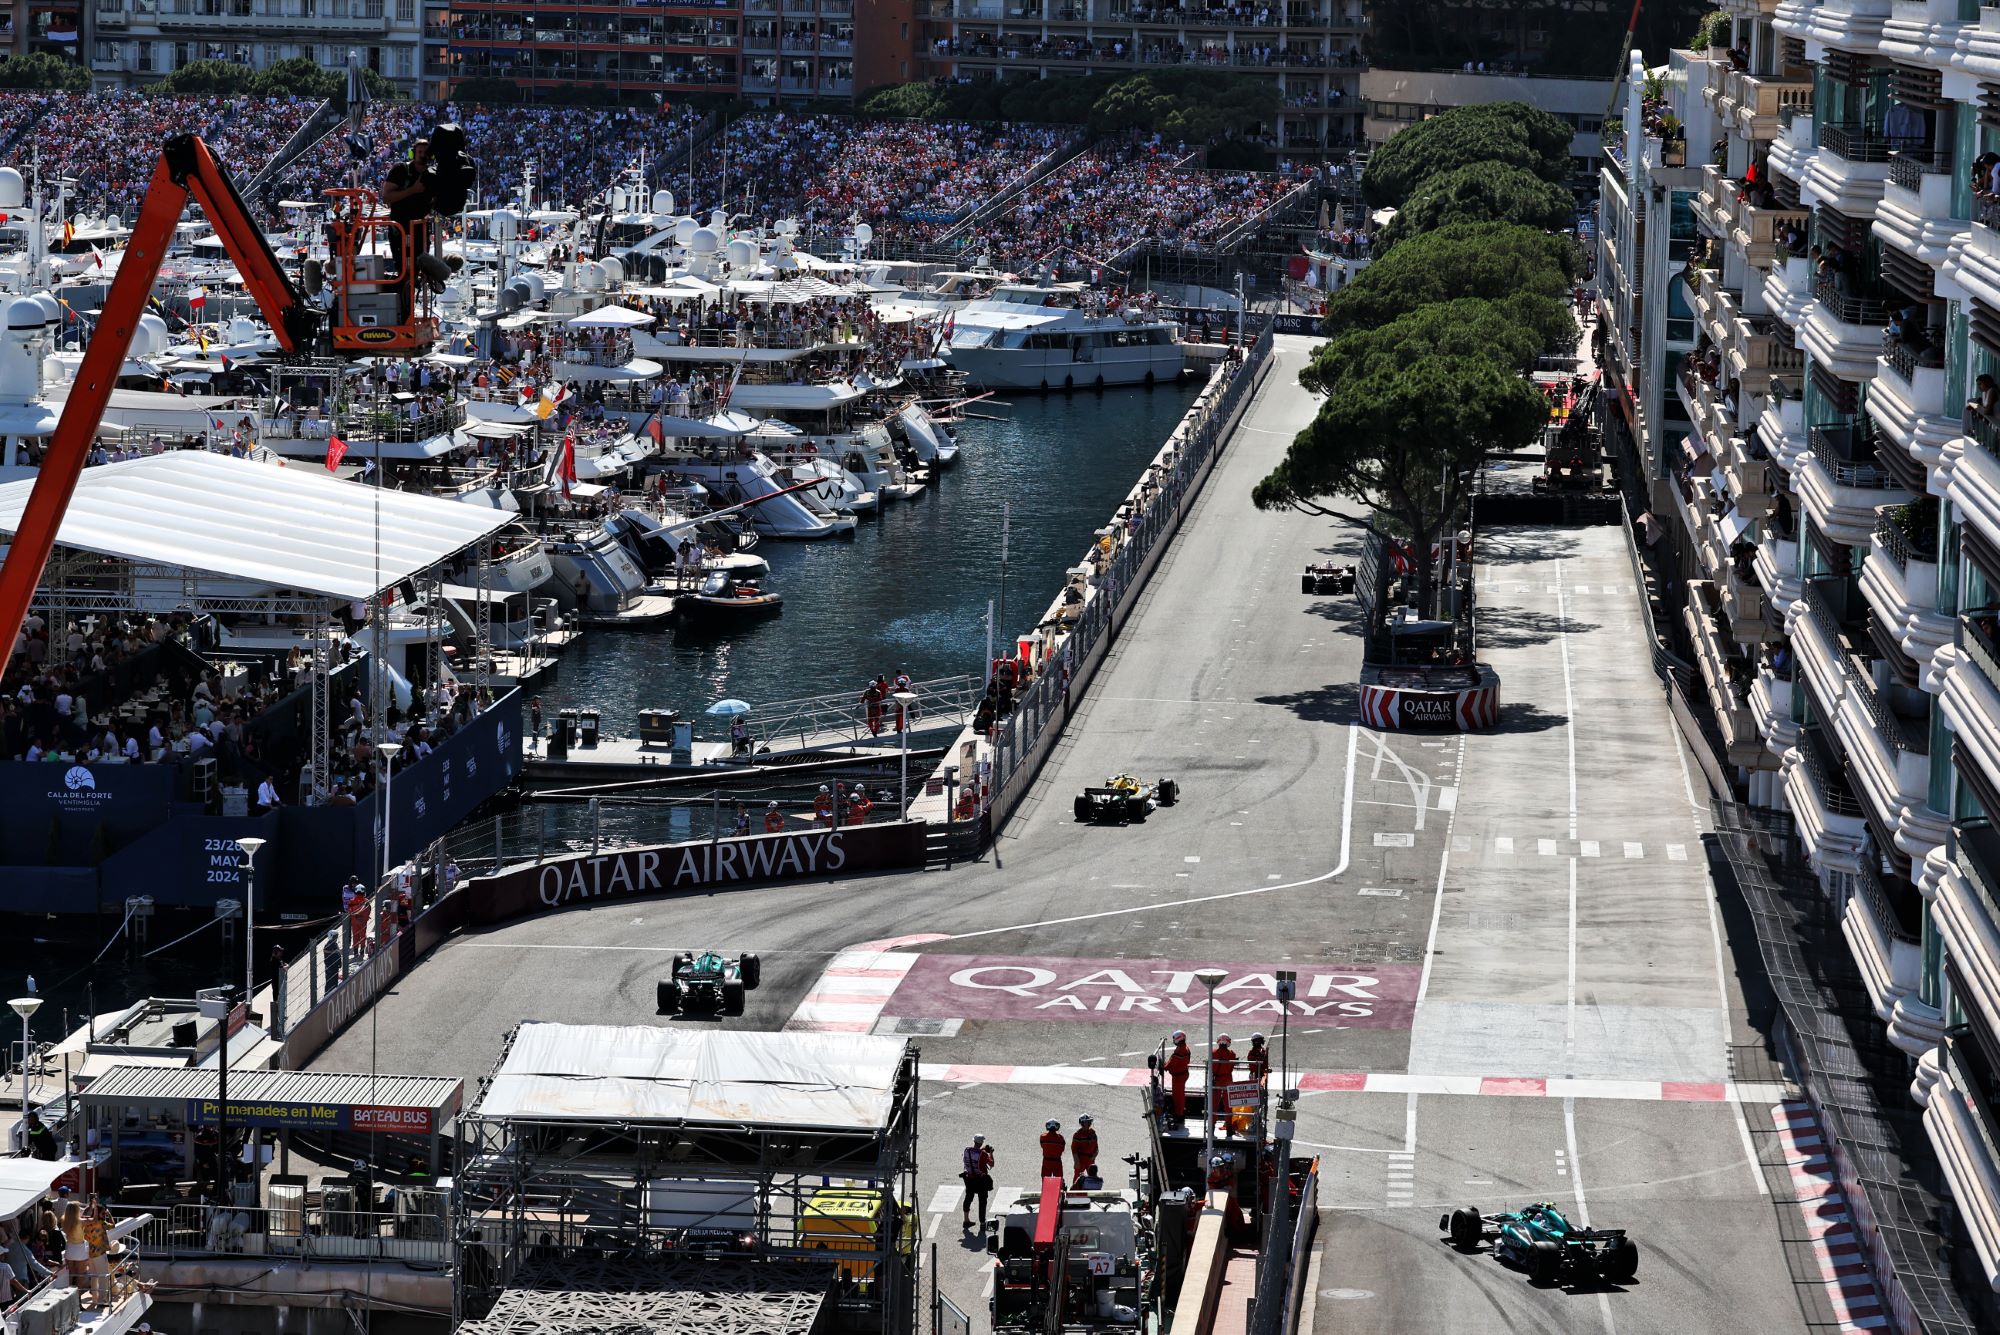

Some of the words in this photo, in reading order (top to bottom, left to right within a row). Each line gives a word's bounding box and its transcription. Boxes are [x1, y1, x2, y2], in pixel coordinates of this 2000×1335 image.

[1283, 318, 1301, 328] MSC
[1404, 700, 1450, 714] QATAR
[204, 839, 242, 851] 23/26
[210, 855, 240, 866] MAY
[540, 852, 662, 906] QATAR
[674, 832, 845, 885] AIRWAYS
[208, 870, 240, 882] 2024
[949, 966, 1382, 998] QATAR
[327, 980, 357, 1034] QATAR
[360, 946, 393, 1002] AIRWAYS
[1034, 994, 1374, 1017] AIRWAYS
[204, 1102, 288, 1116] Prmenades
[291, 1108, 308, 1118] en
[311, 1106, 338, 1118] Mer
[354, 1110, 400, 1122] BATEAU
[404, 1112, 428, 1123] BUS
[1094, 1262, 1110, 1274] A7
